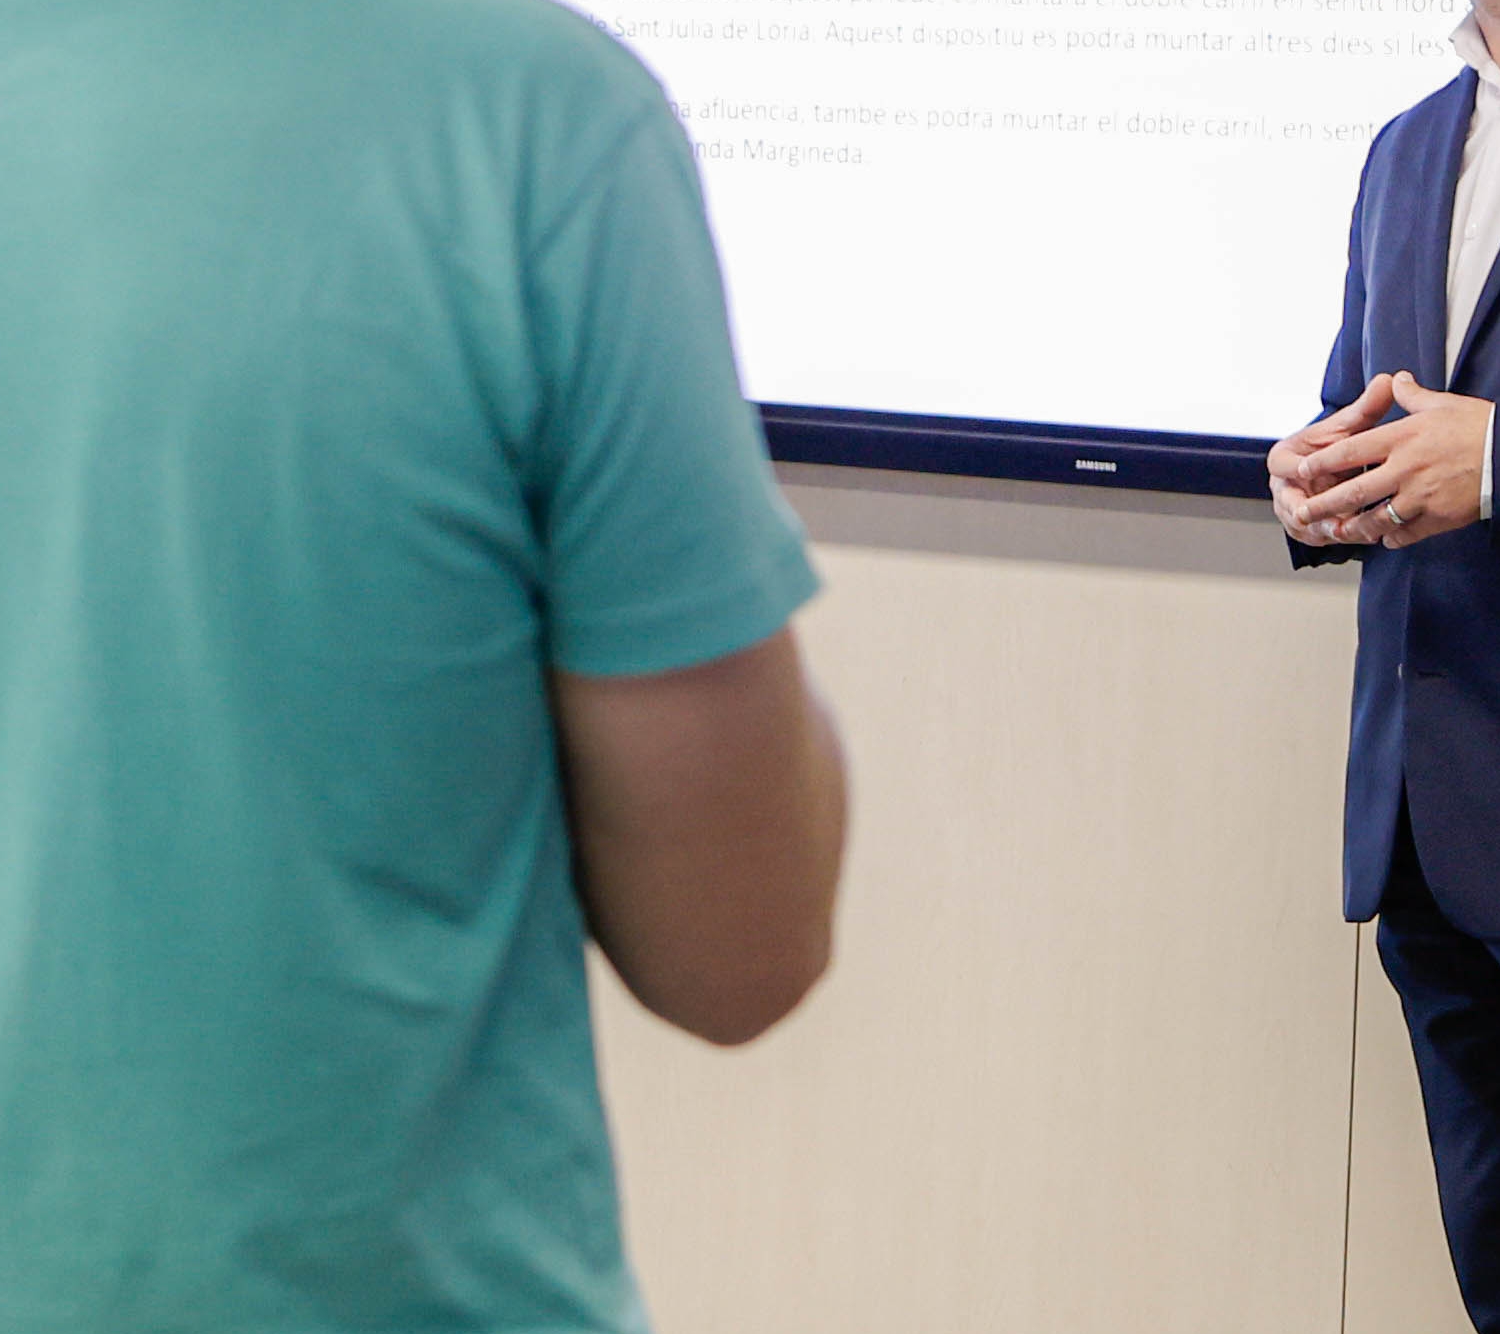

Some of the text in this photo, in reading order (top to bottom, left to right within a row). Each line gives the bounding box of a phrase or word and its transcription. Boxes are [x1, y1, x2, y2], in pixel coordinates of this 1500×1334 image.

[613, 14, 659, 39] Sant
[721, 16, 749, 41] de
[824, 18, 903, 50] Aquest
[911, 20, 1024, 53] dispositiu
[1032, 31, 1058, 48] es
[1144, 28, 1233, 52] muntar
[1244, 27, 1313, 54] altres
[1322, 28, 1374, 55] dies
[1409, 30, 1447, 57] les
[894, 108, 919, 126] es
[1002, 107, 1089, 132] muntar
[1097, 107, 1118, 133] el
[1126, 108, 1196, 135] doble
[1282, 121, 1313, 140] en
[1074, 458, 1117, 473] SAMSUNG
